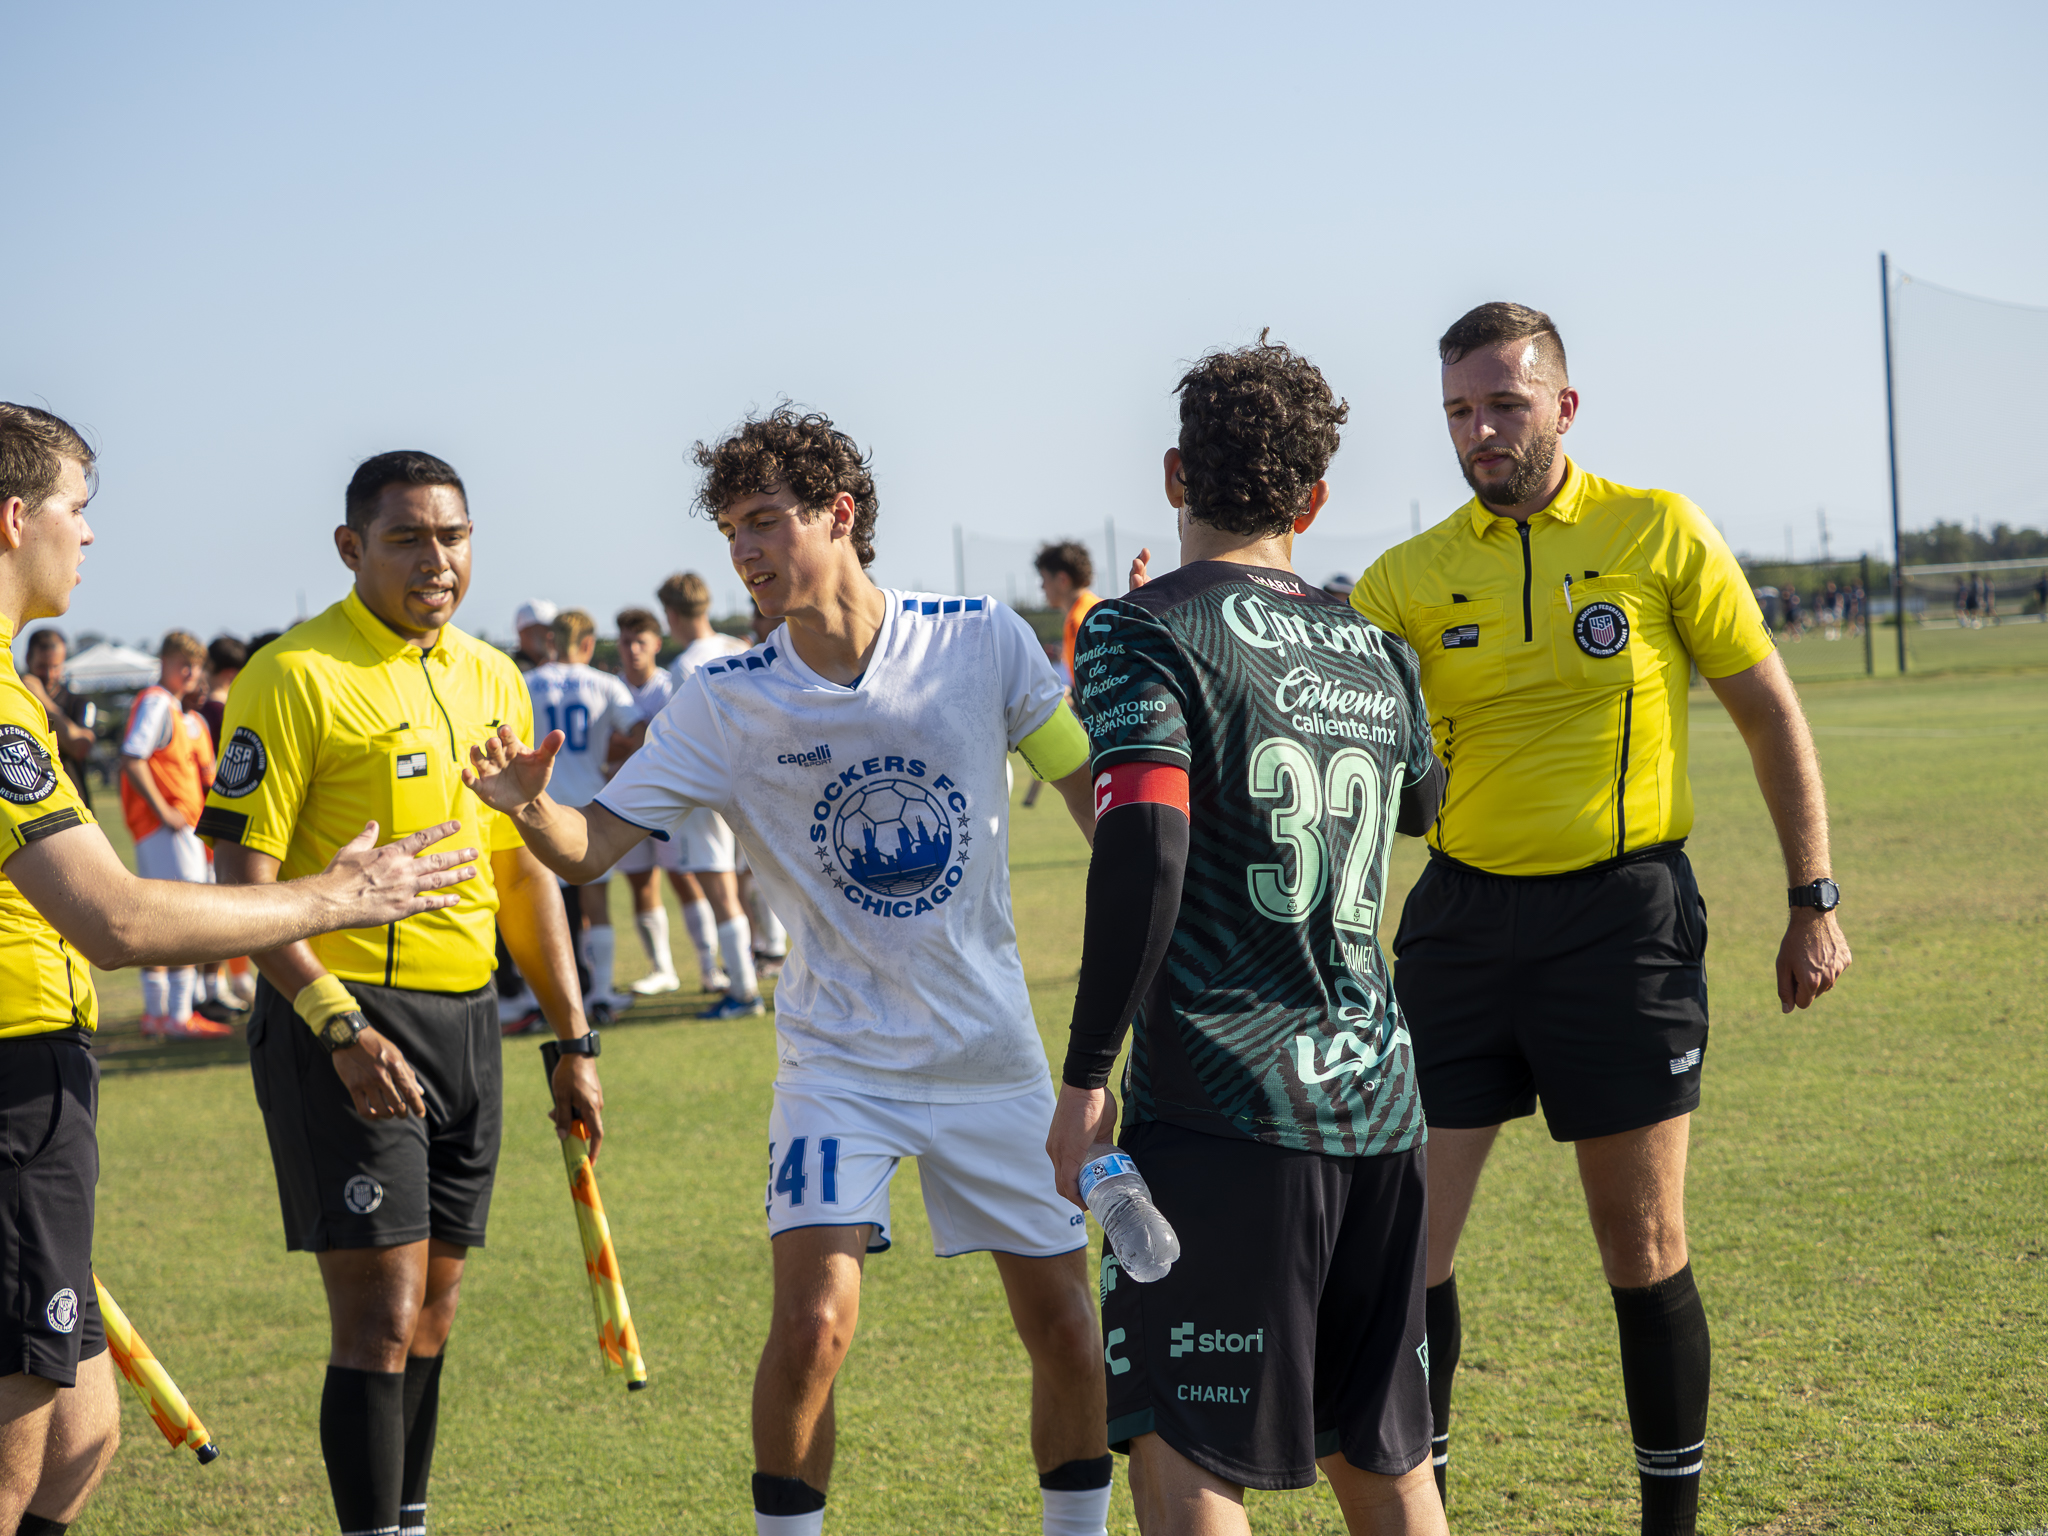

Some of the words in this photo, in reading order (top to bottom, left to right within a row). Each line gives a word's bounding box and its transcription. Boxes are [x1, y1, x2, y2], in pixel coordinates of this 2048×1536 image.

[1246, 573, 1301, 595] CHARLY
[1580, 604, 1598, 622] SOCCER
[1598, 604, 1627, 626] FEDERATION
[1590, 615, 1612, 630] USA
[1221, 593, 1390, 662] Corona
[1089, 661, 1107, 678] de
[1082, 674, 1131, 705] México
[1272, 664, 1396, 720] Caliente
[1094, 713, 1148, 737] ESPAÑOL
[1095, 700, 1167, 728] SANATORIO
[1292, 712, 1397, 746] caliente.mx
[0, 743, 28, 764] USA
[226, 744, 252, 763] USA
[777, 744, 832, 767] capelli
[804, 758, 832, 767] SPORT
[0, 787, 35, 802] REFEREE
[810, 756, 926, 843] SOCKERS
[932, 774, 967, 814] FC
[844, 866, 963, 919] CHICAGO
[775, 1136, 840, 1208] 41
[1198, 1328, 1264, 1354] stori
[1177, 1385, 1250, 1404] CHARLY
